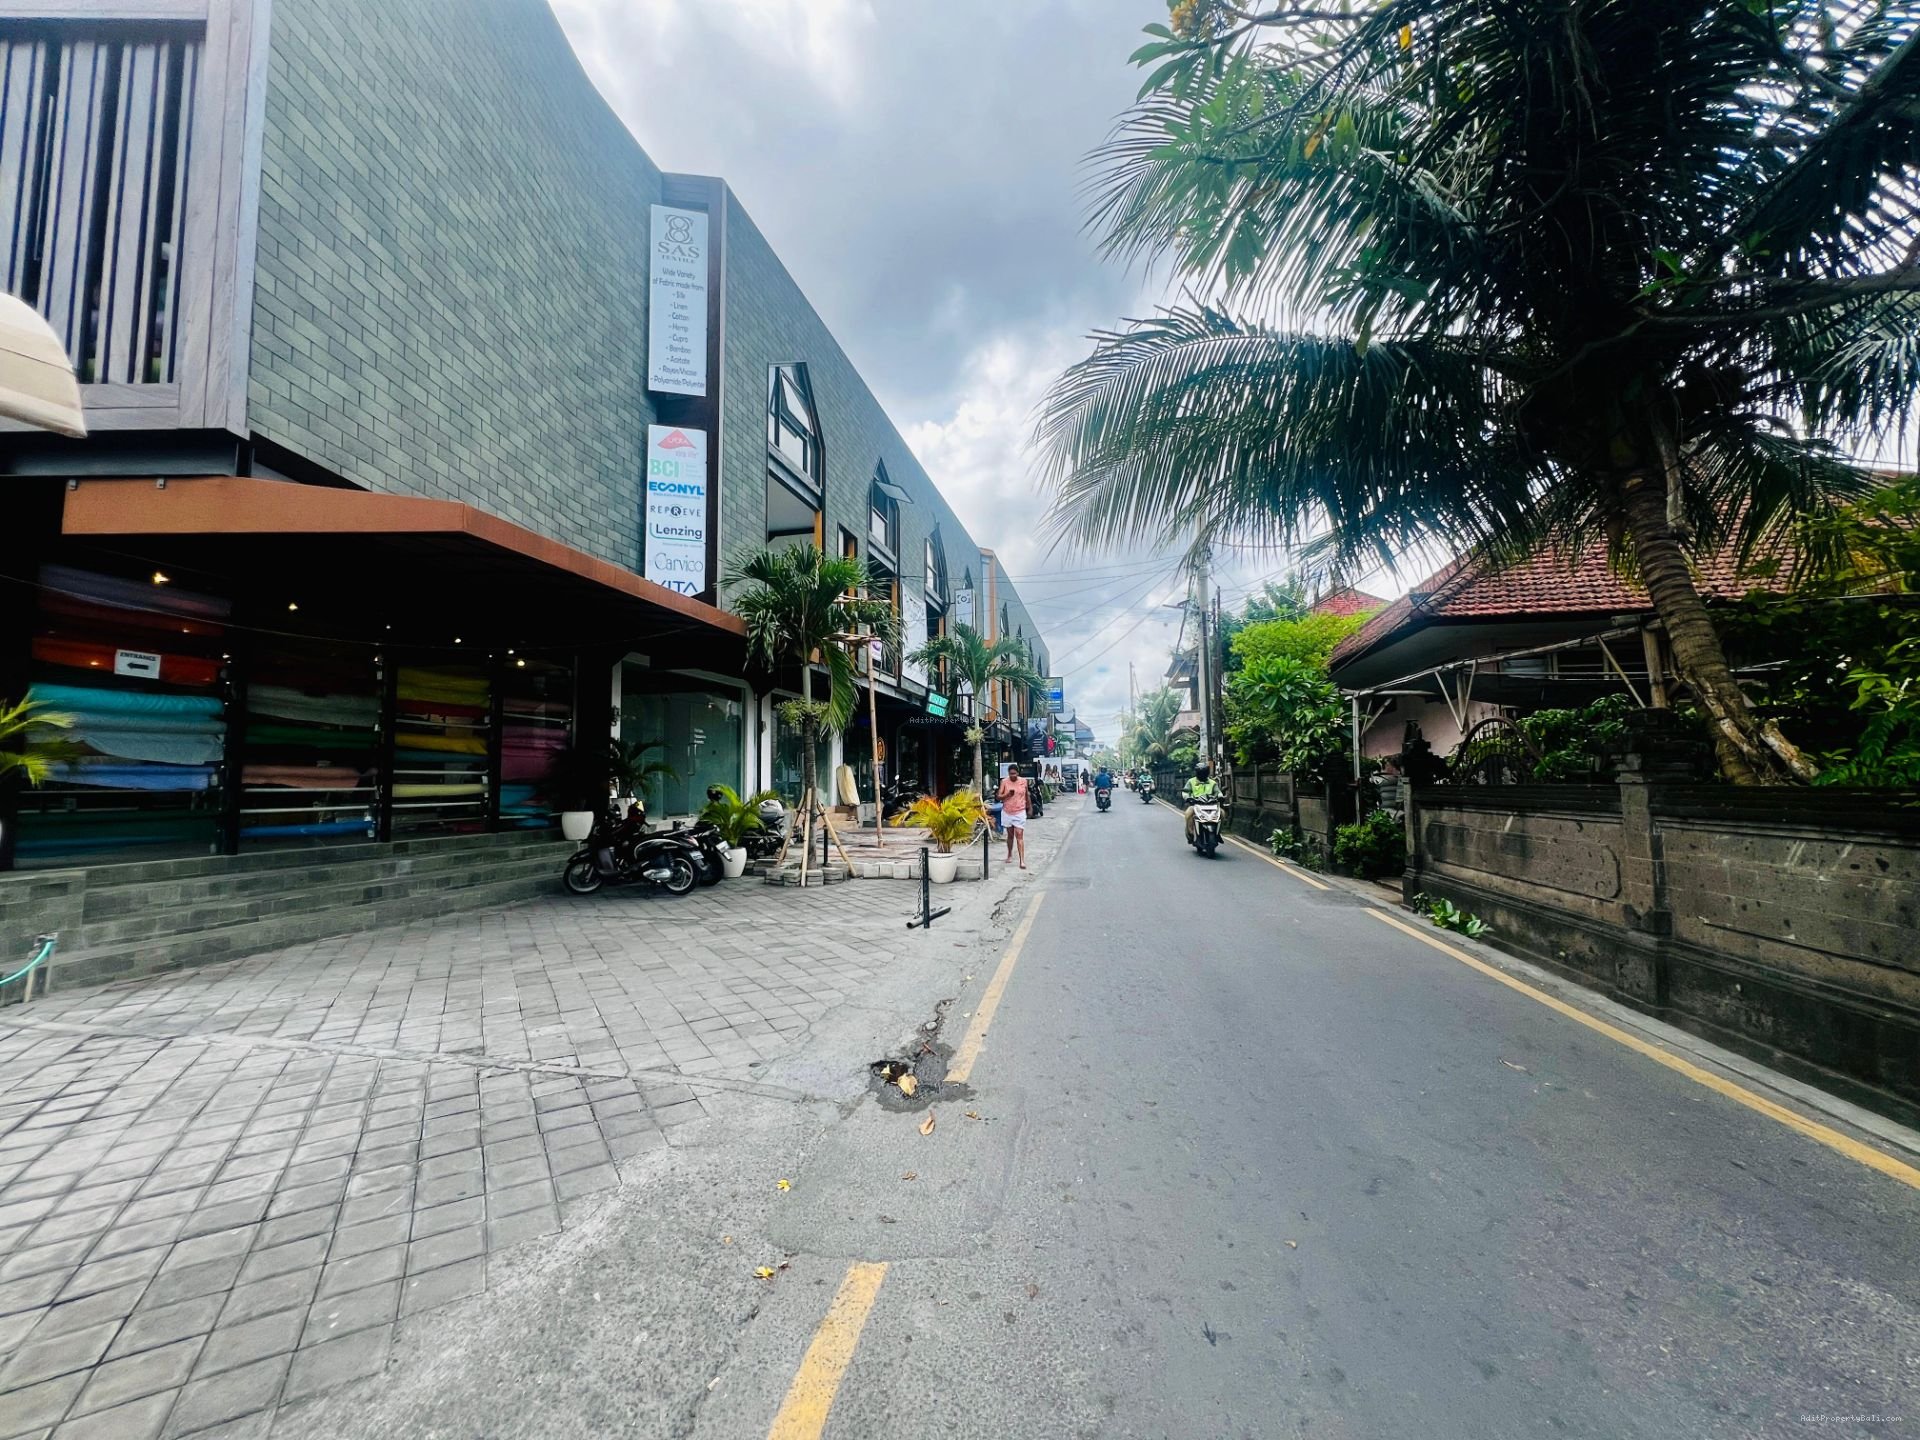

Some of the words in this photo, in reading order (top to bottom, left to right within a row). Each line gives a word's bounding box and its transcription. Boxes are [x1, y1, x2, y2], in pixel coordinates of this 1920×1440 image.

[657, 241, 700, 259] SAS
[662, 267, 676, 277] Wide
[676, 269, 696, 281] Variety
[659, 278, 675, 288] Fabric
[675, 282, 690, 290] made
[673, 302, 688, 311] Linen
[671, 312, 689, 321] Cotton
[672, 323, 689, 333] Hemp
[672, 334, 689, 344] Cupro
[669, 345, 692, 354] Bamboo
[670, 356, 690, 365] Acetate
[650, 459, 680, 478] BCI
[648, 481, 705, 496] ECONYL
[650, 505, 702, 518] REPREVE
[656, 523, 703, 540] Lenzing
[654, 552, 704, 573] Carvico
